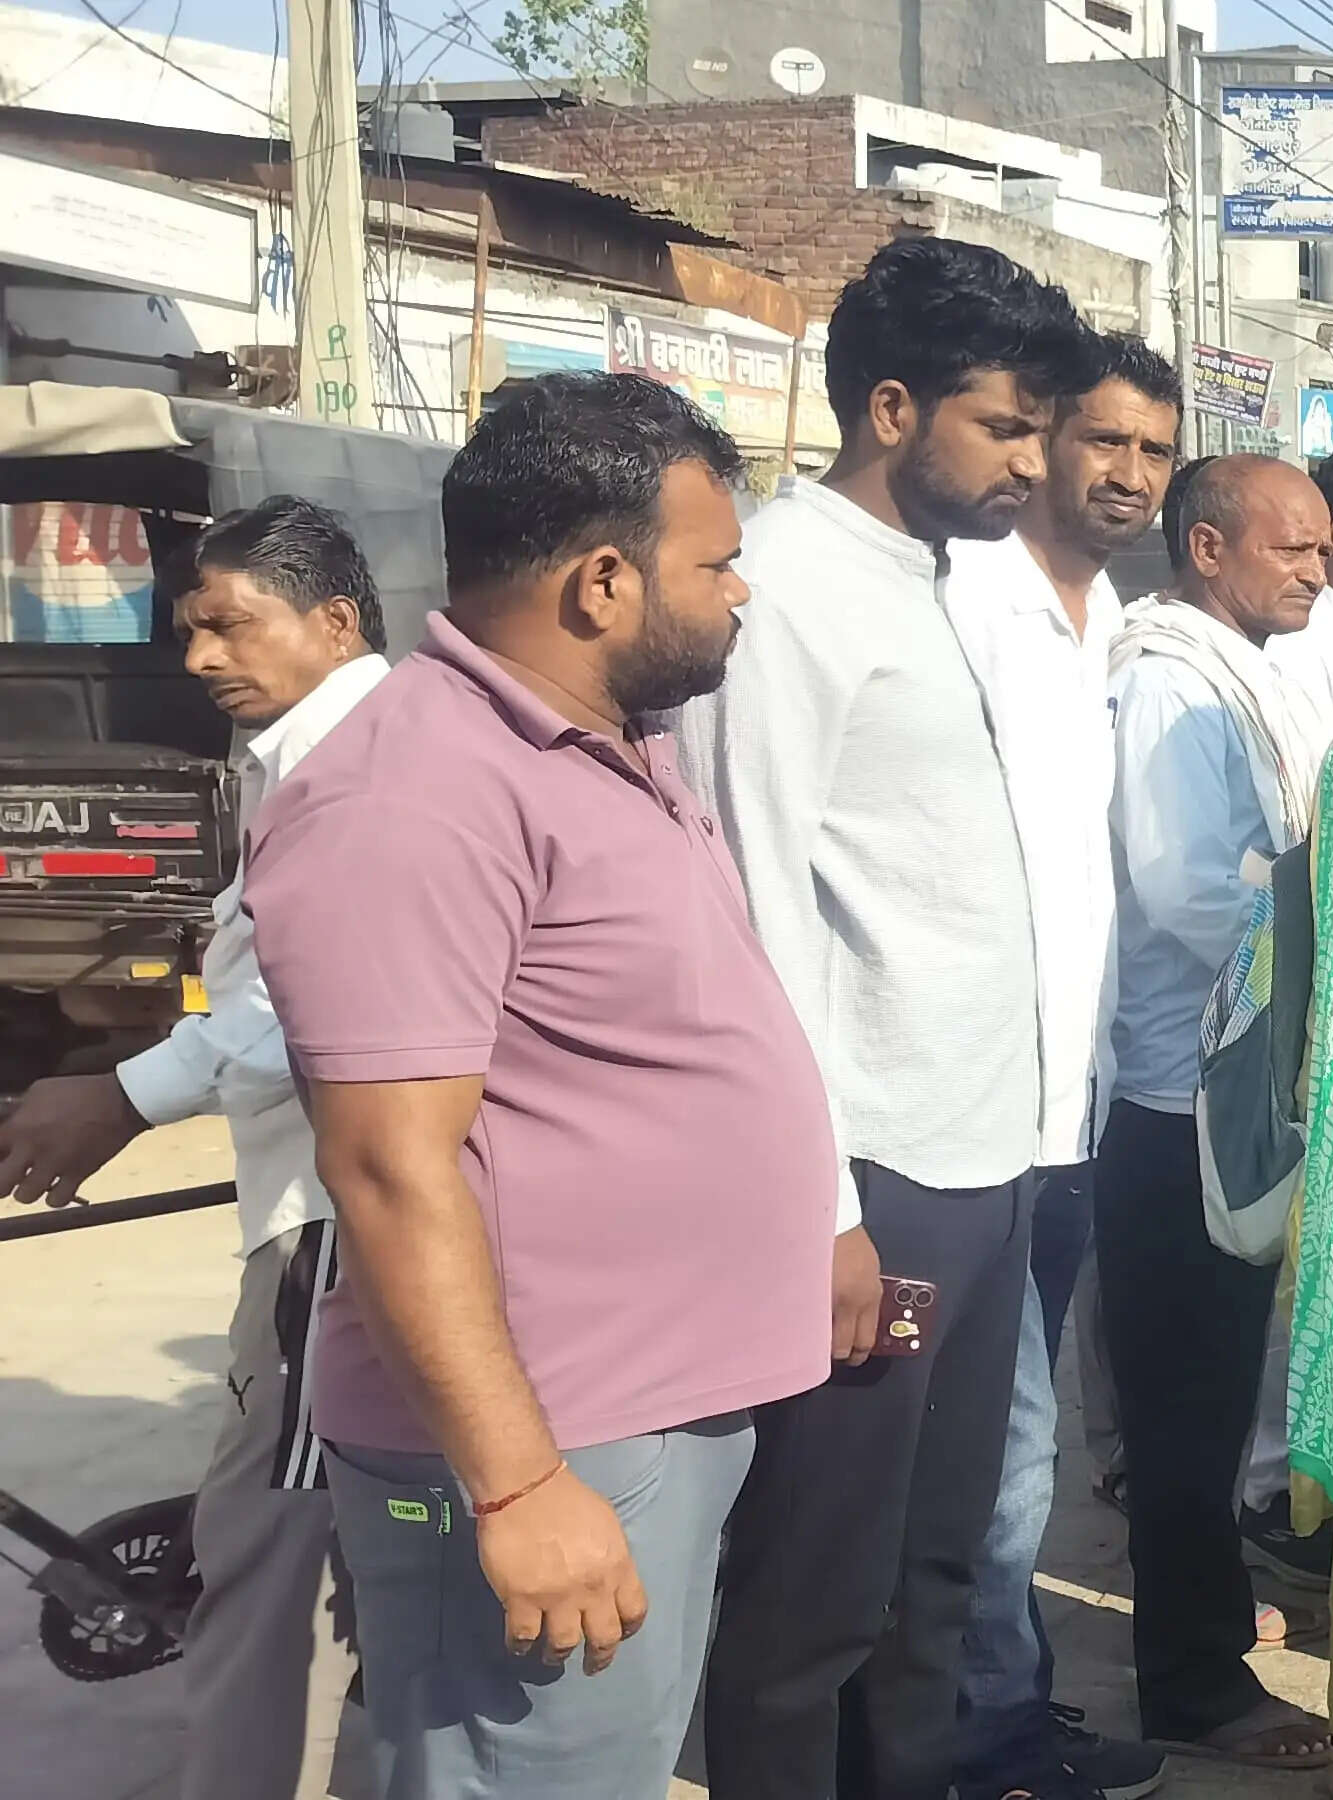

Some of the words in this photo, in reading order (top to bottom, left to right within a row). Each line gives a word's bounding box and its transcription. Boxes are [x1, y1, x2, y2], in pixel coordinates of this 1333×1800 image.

[613, 315, 647, 369] श्री
[649, 331, 731, 385] बनवारी
[733, 347, 784, 391] लाल
[0, 801, 91, 833] JAJ
